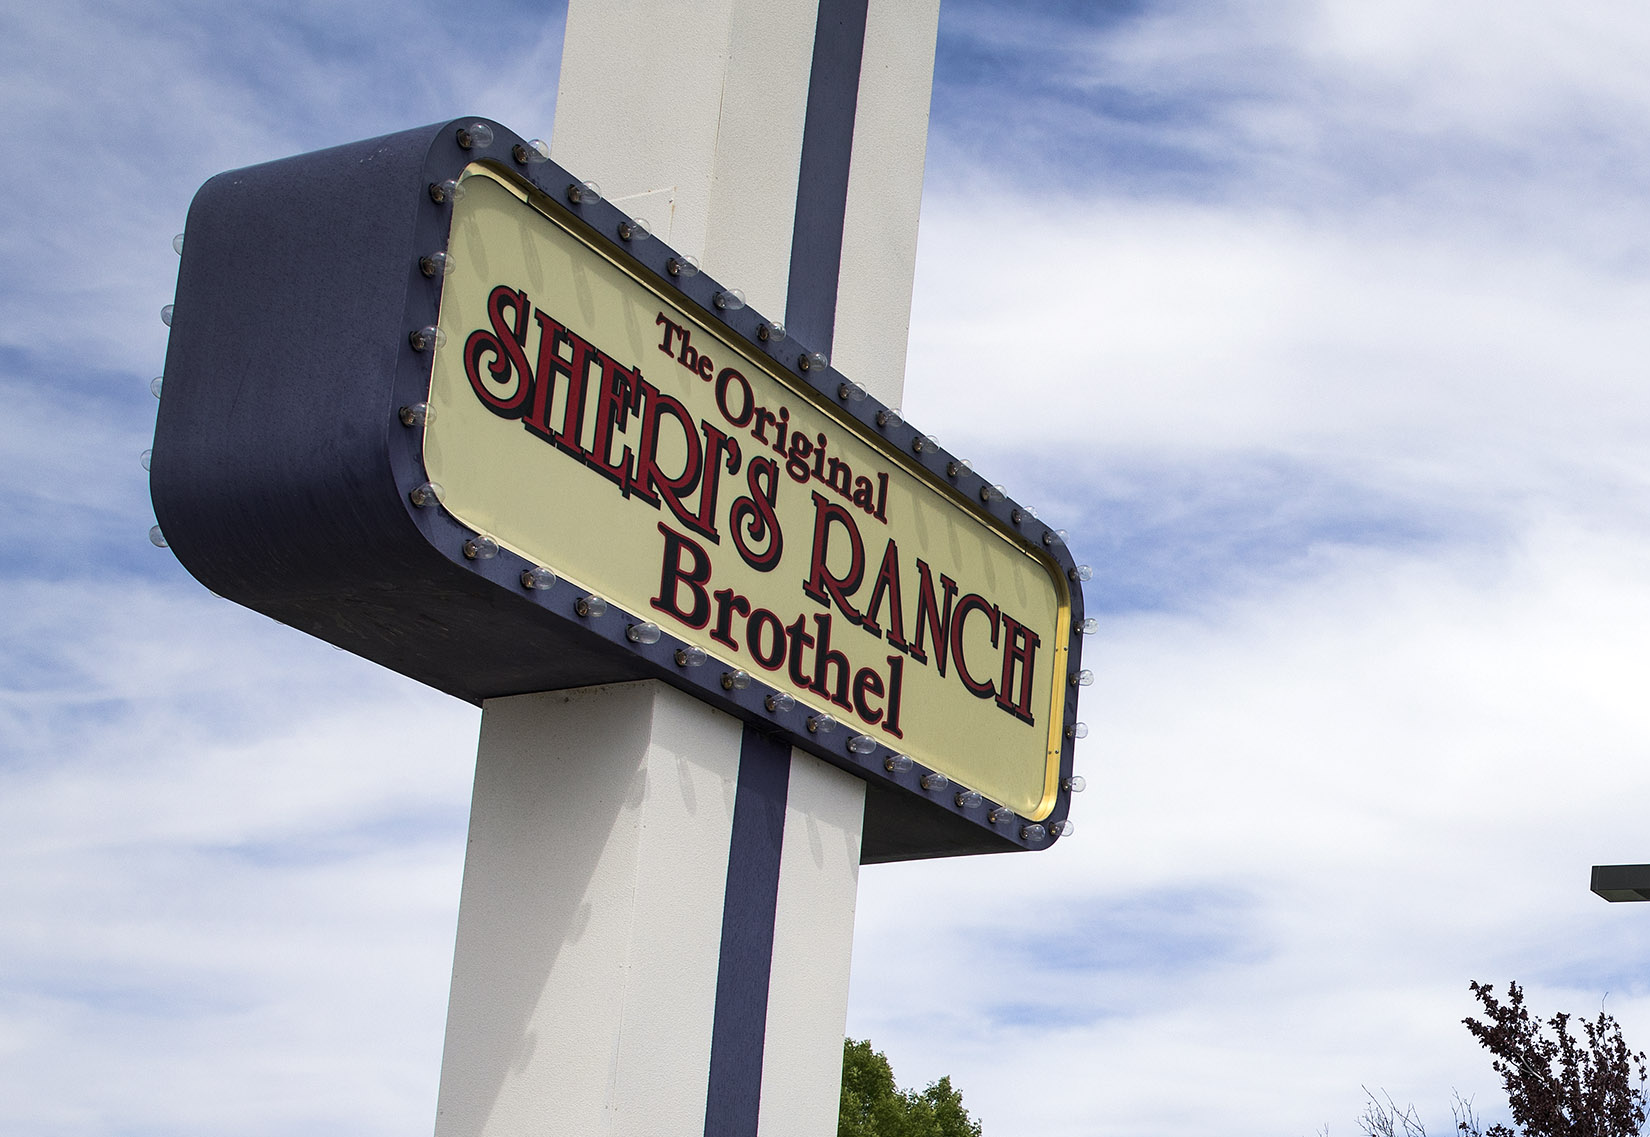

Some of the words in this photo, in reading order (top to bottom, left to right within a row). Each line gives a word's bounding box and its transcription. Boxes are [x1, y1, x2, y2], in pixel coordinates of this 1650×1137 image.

[463, 284, 784, 574] SHERI'S
[803, 489, 1042, 727] RANCH
[655, 311, 714, 383] The
[714, 367, 890, 524] Original
[649, 521, 905, 740] Brothel
